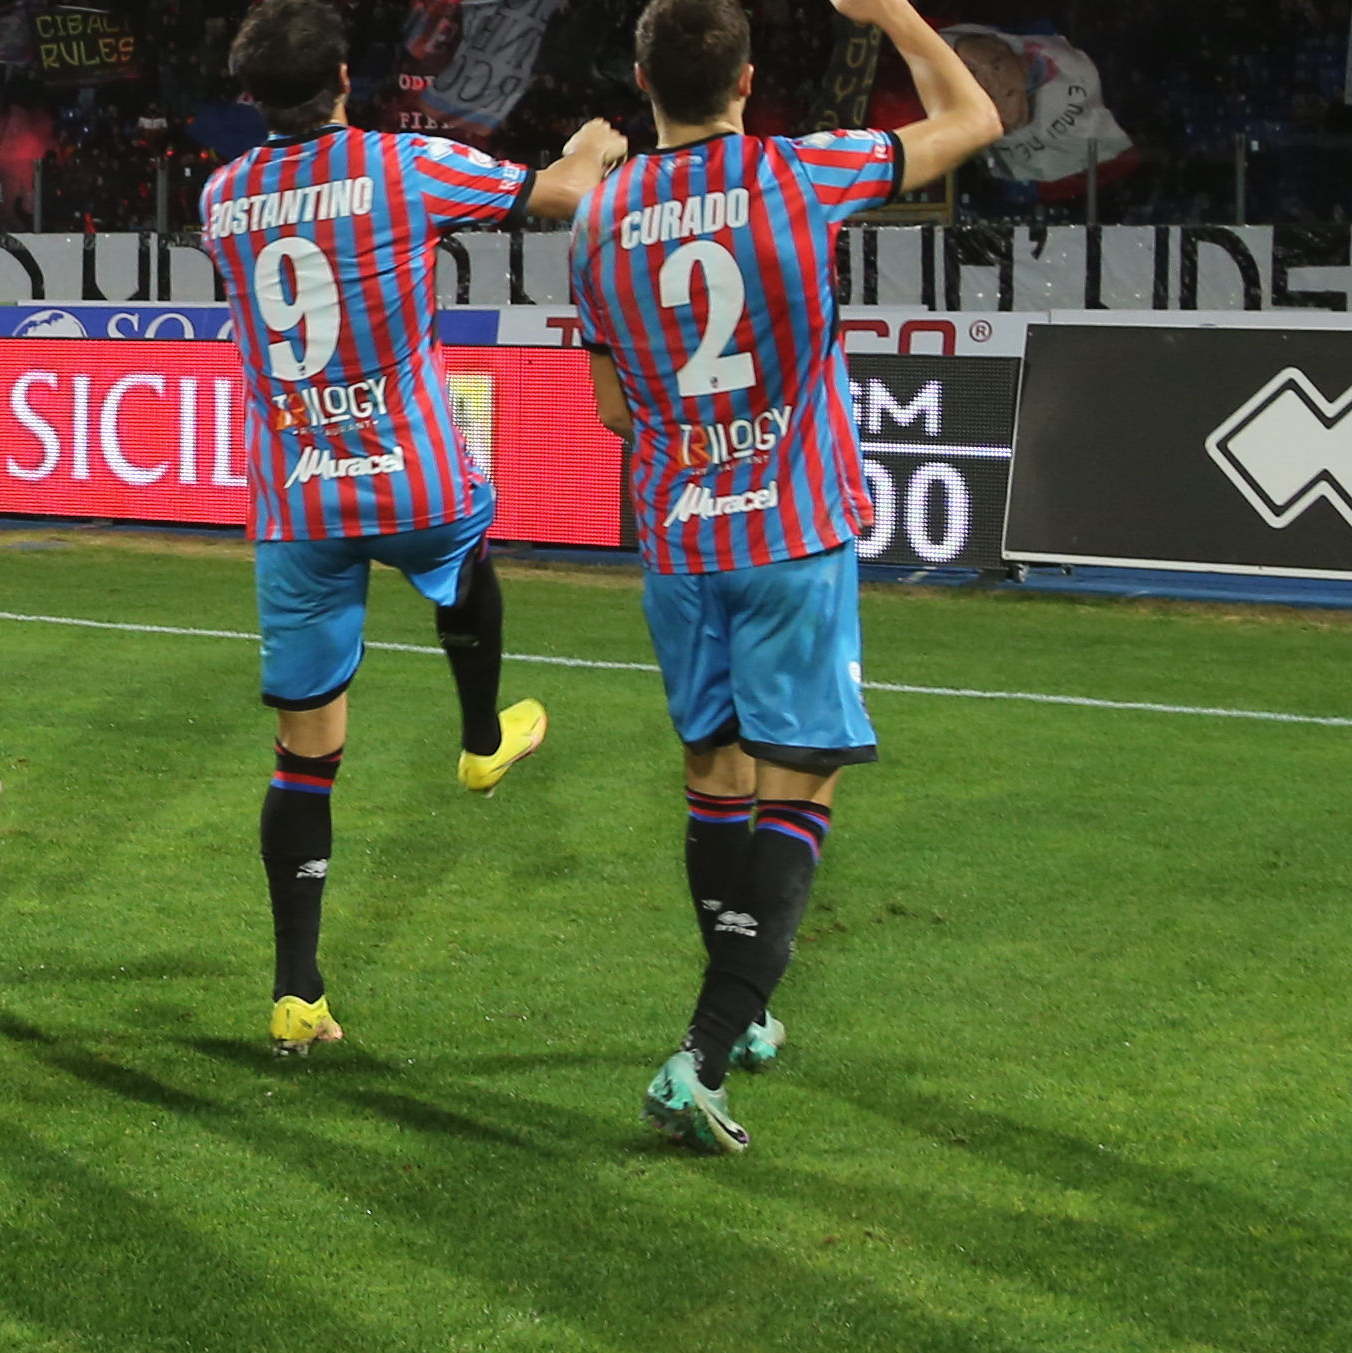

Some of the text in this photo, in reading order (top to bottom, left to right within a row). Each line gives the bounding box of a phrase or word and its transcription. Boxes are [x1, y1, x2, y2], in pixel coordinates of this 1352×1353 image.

[621, 187, 750, 249] CURADO
[255, 236, 343, 381] 9
[660, 240, 757, 398] 2
[272, 375, 387, 430] TRILOGY
[283, 445, 405, 489] Muracel
[677, 405, 793, 468] TRILOGY
[663, 480, 779, 528] Muracel
